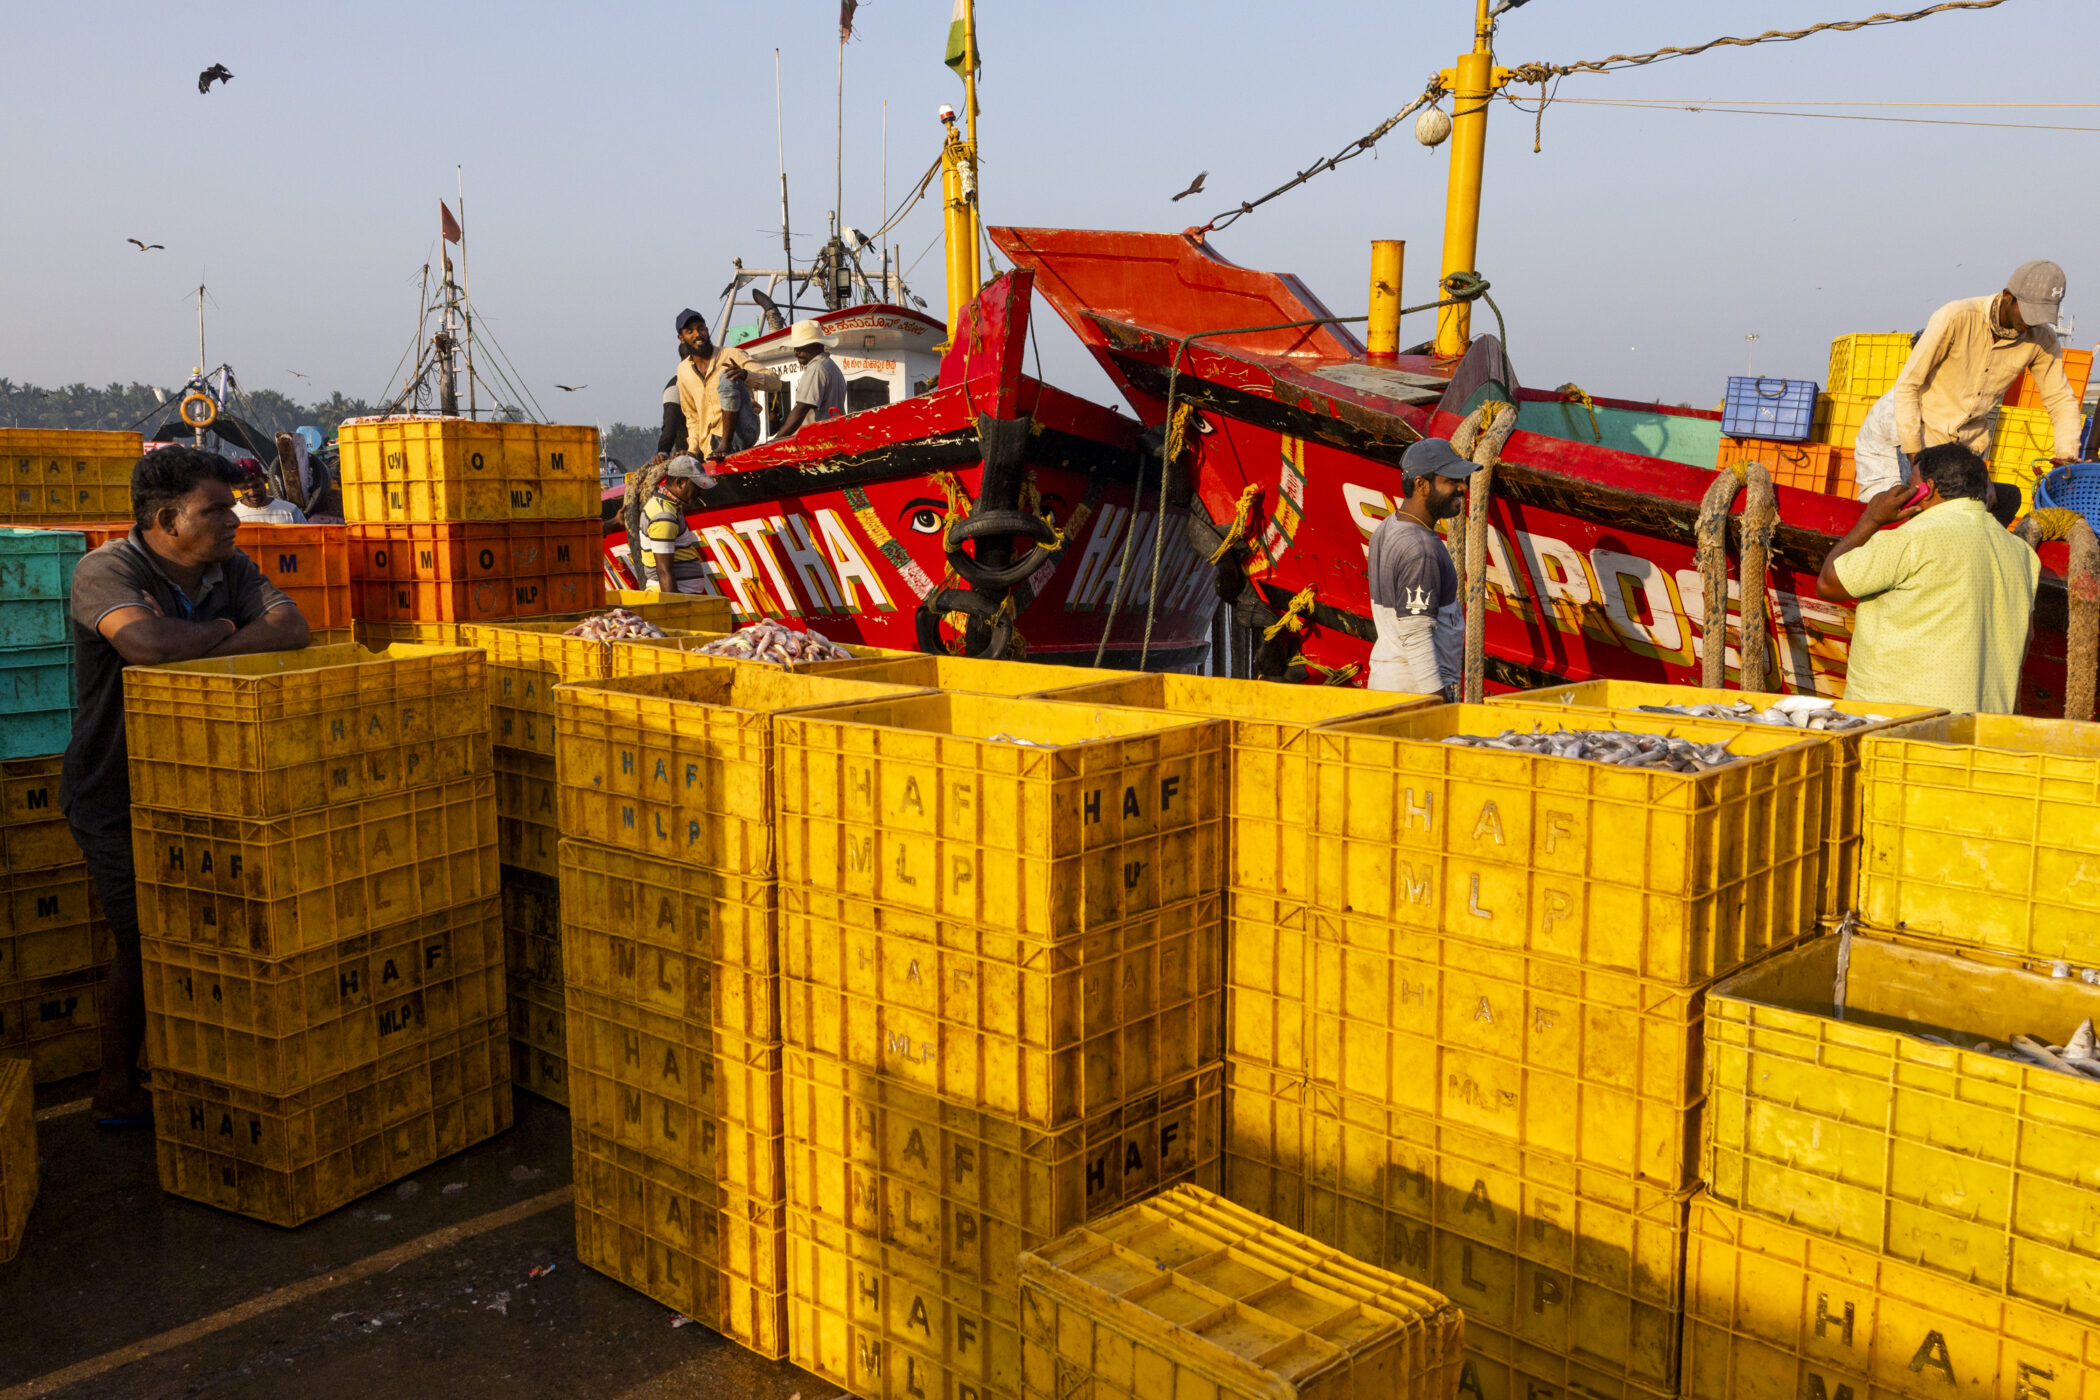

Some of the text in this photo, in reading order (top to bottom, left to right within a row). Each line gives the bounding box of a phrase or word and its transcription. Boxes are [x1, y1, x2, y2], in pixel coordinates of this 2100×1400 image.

[511, 490, 532, 508] MLP
[279, 554, 297, 573] M
[27, 788, 48, 810] M
[379, 1003, 413, 1038] MLP
